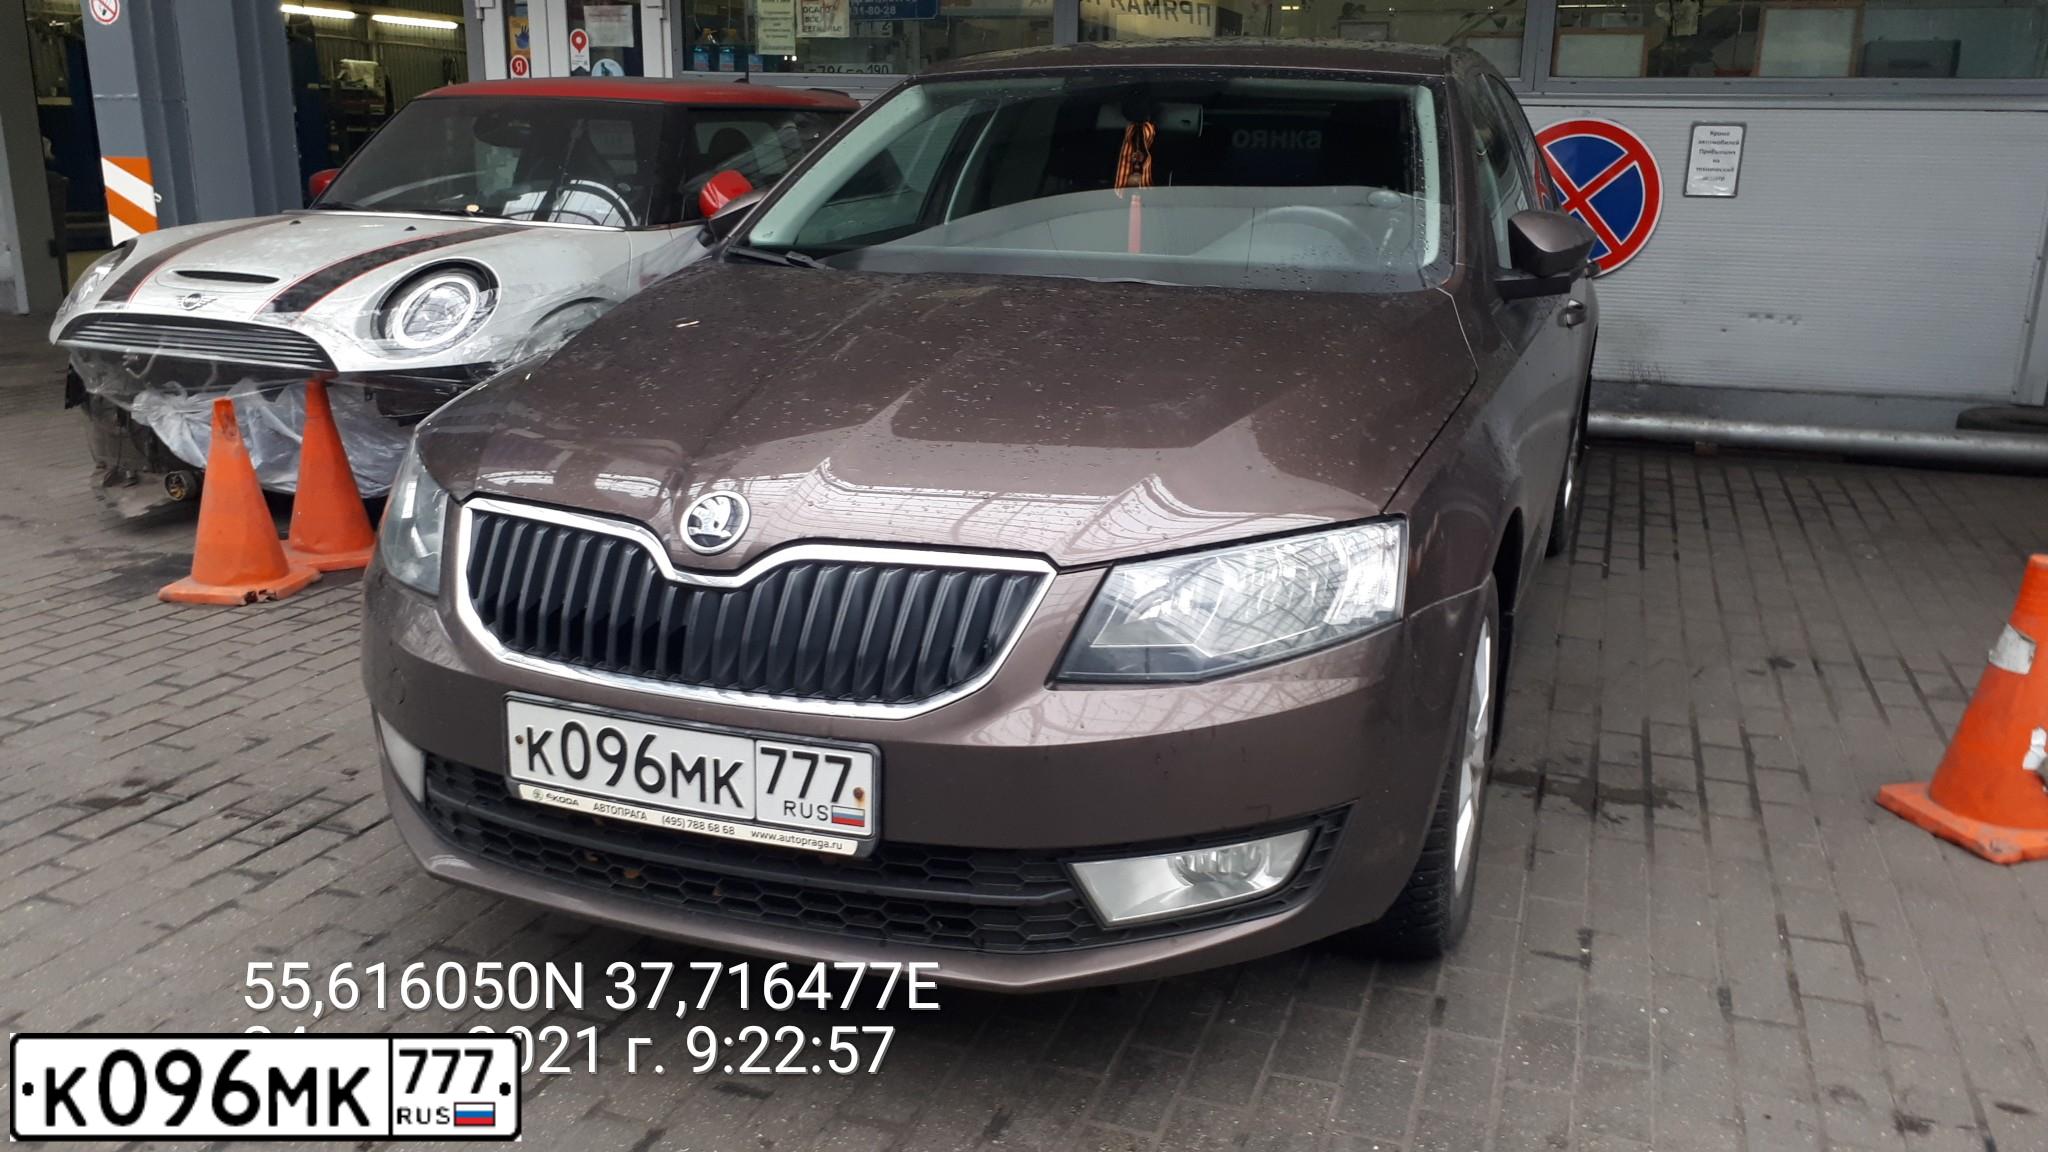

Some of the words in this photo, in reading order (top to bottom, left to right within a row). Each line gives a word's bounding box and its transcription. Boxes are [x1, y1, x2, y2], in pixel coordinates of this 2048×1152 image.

[526, 720, 744, 808] К096МК
[760, 747, 852, 803] 777
[592, 801, 648, 821] АВТОПРАГА
[661, 815, 686, 829] (495)
[687, 819, 706, 831] 788
[707, 823, 720, 834] 68
[722, 825, 735, 836] 68
[751, 828, 843, 851] www.autopraga.ru
[783, 800, 829, 822] RUS
